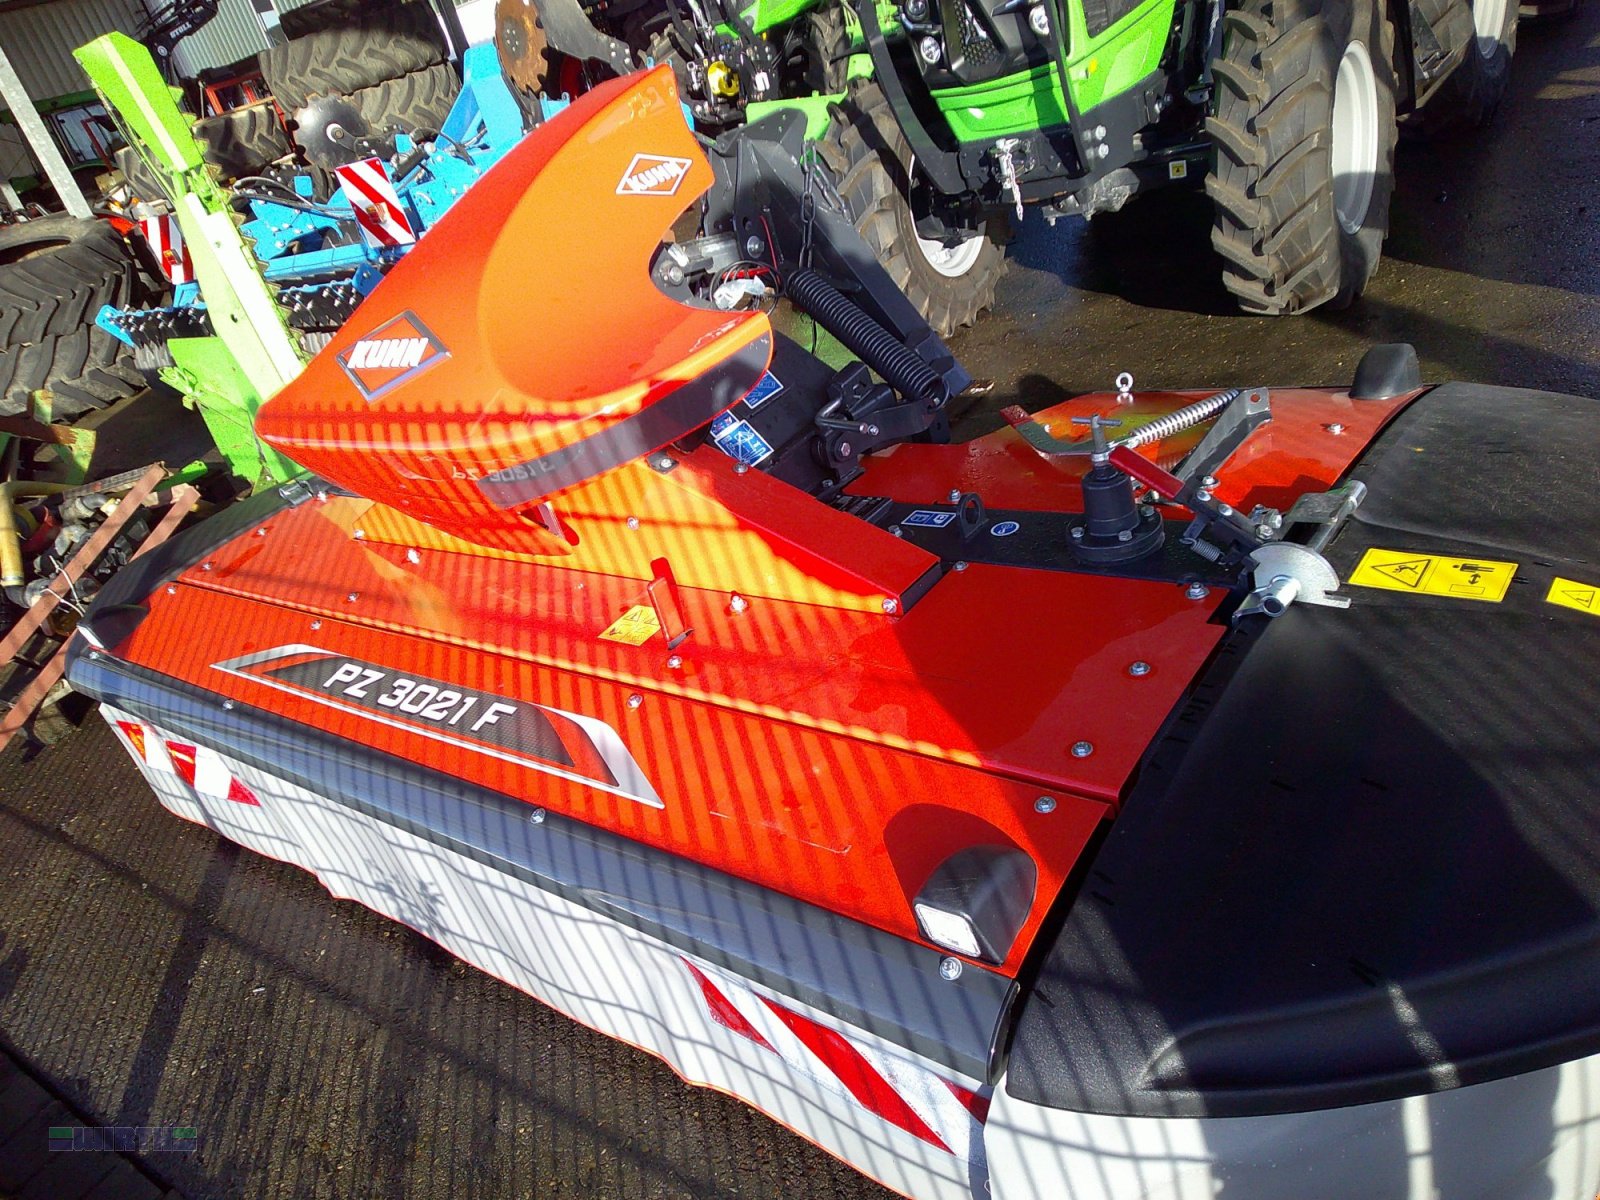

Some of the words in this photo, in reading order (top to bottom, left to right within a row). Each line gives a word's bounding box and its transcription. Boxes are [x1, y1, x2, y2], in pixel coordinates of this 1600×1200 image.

[624, 160, 683, 192] KUHN
[347, 336, 429, 369] KUHN
[323, 663, 386, 699] PZ
[377, 678, 478, 725] 3021
[470, 702, 518, 732] F
